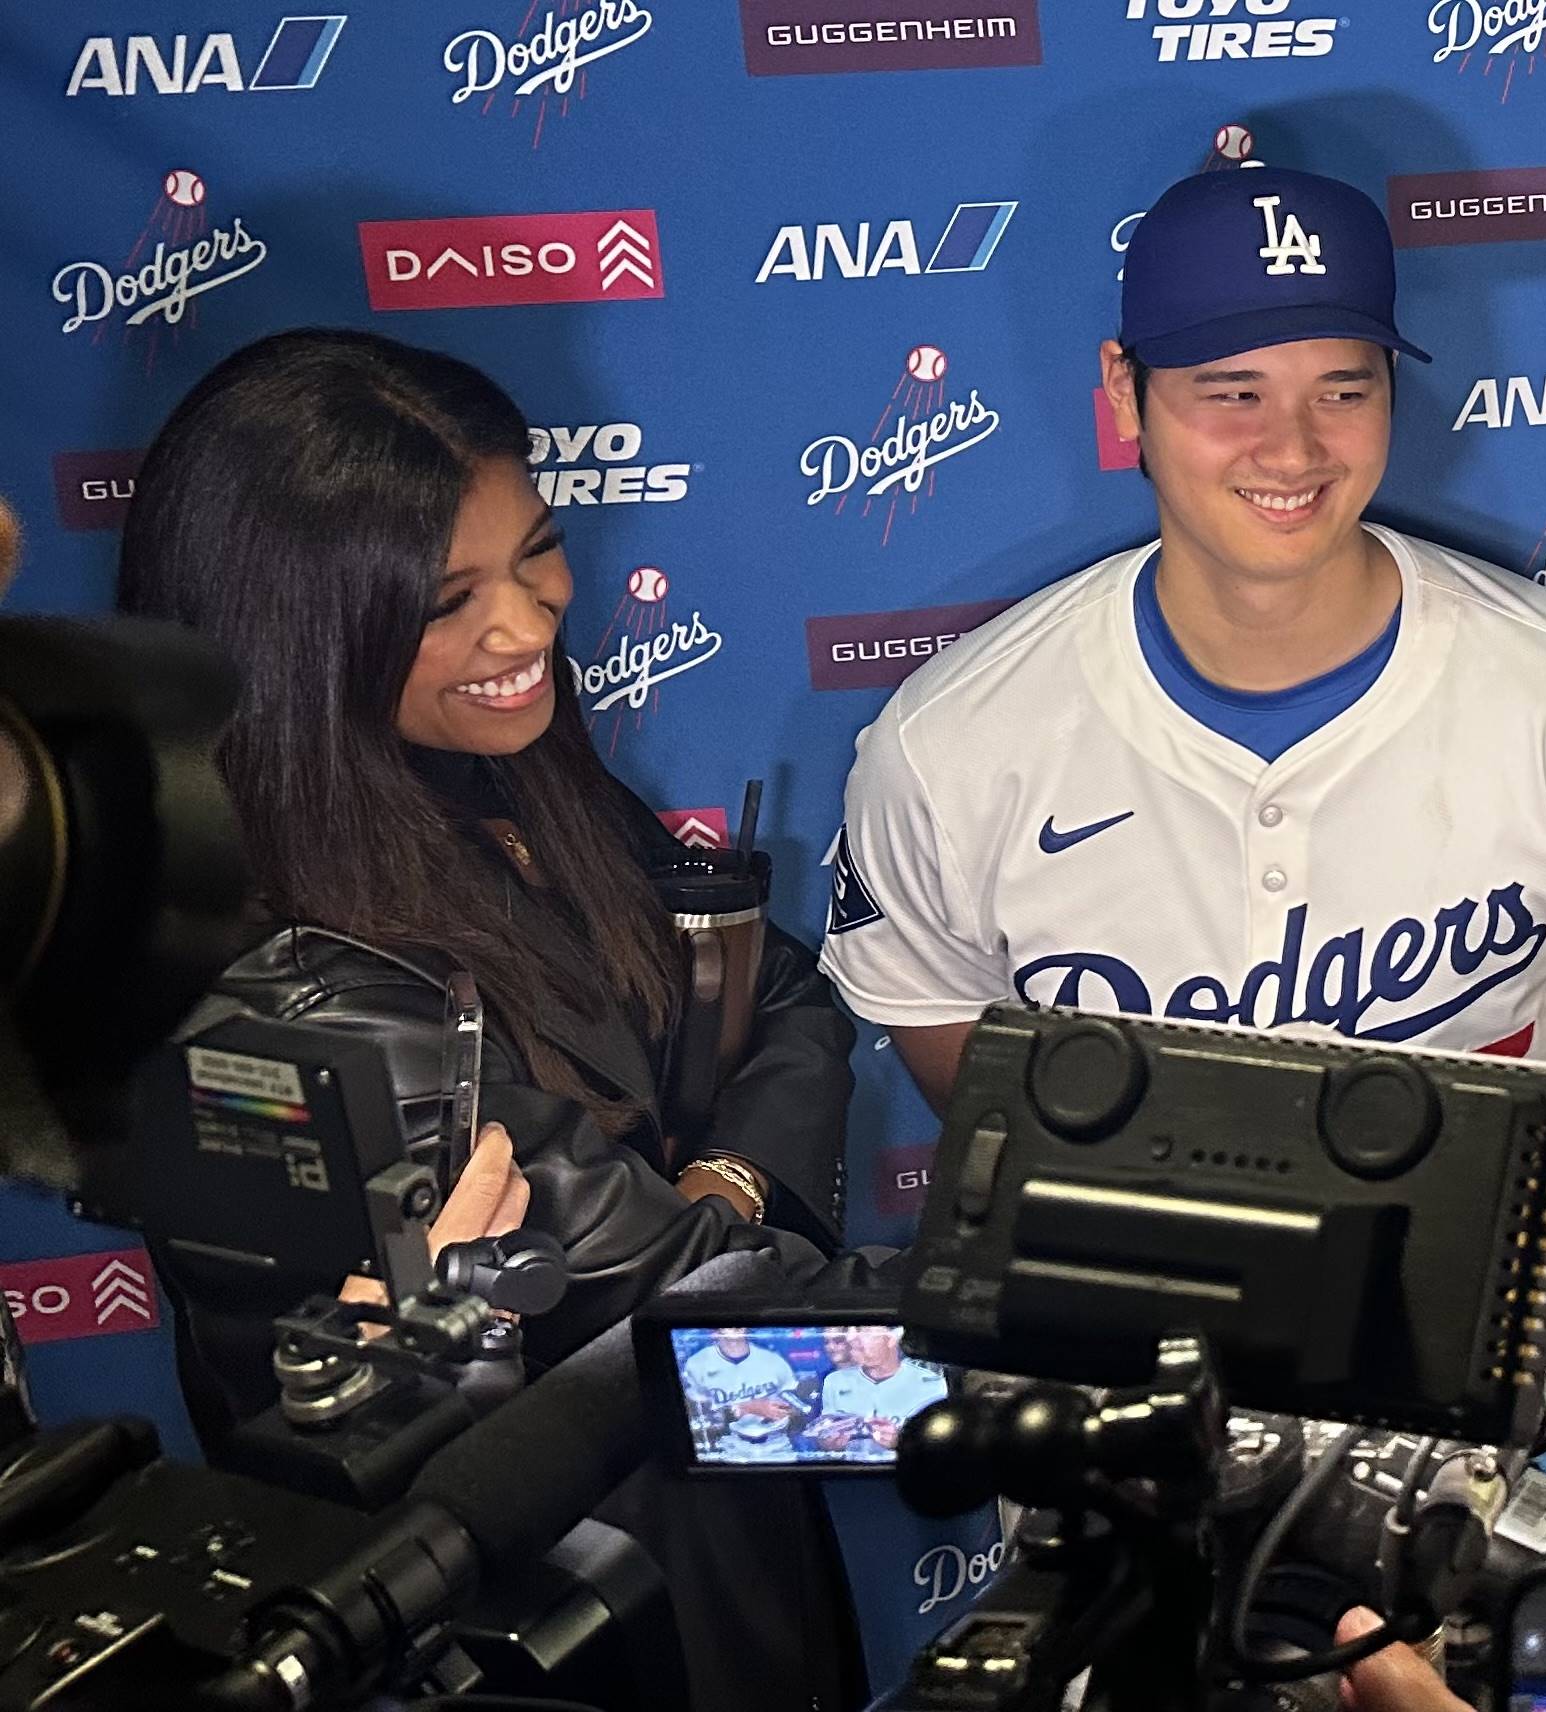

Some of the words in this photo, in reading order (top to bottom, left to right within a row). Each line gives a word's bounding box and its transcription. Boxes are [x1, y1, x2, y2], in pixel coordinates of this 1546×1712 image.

[444, 0, 653, 104] Dodgers
[767, 16, 1017, 46] GUGGENHEIM
[1152, 18, 1338, 62] TIRES
[66, 33, 245, 96] ANA
[386, 242, 577, 282] DAISO
[755, 220, 921, 283] ANA
[1253, 195, 1327, 276] LA
[52, 217, 267, 333] Dodgers
[801, 389, 999, 506] Dodgers
[538, 463, 691, 507] IRES
[831, 633, 956, 663] GUGGE
